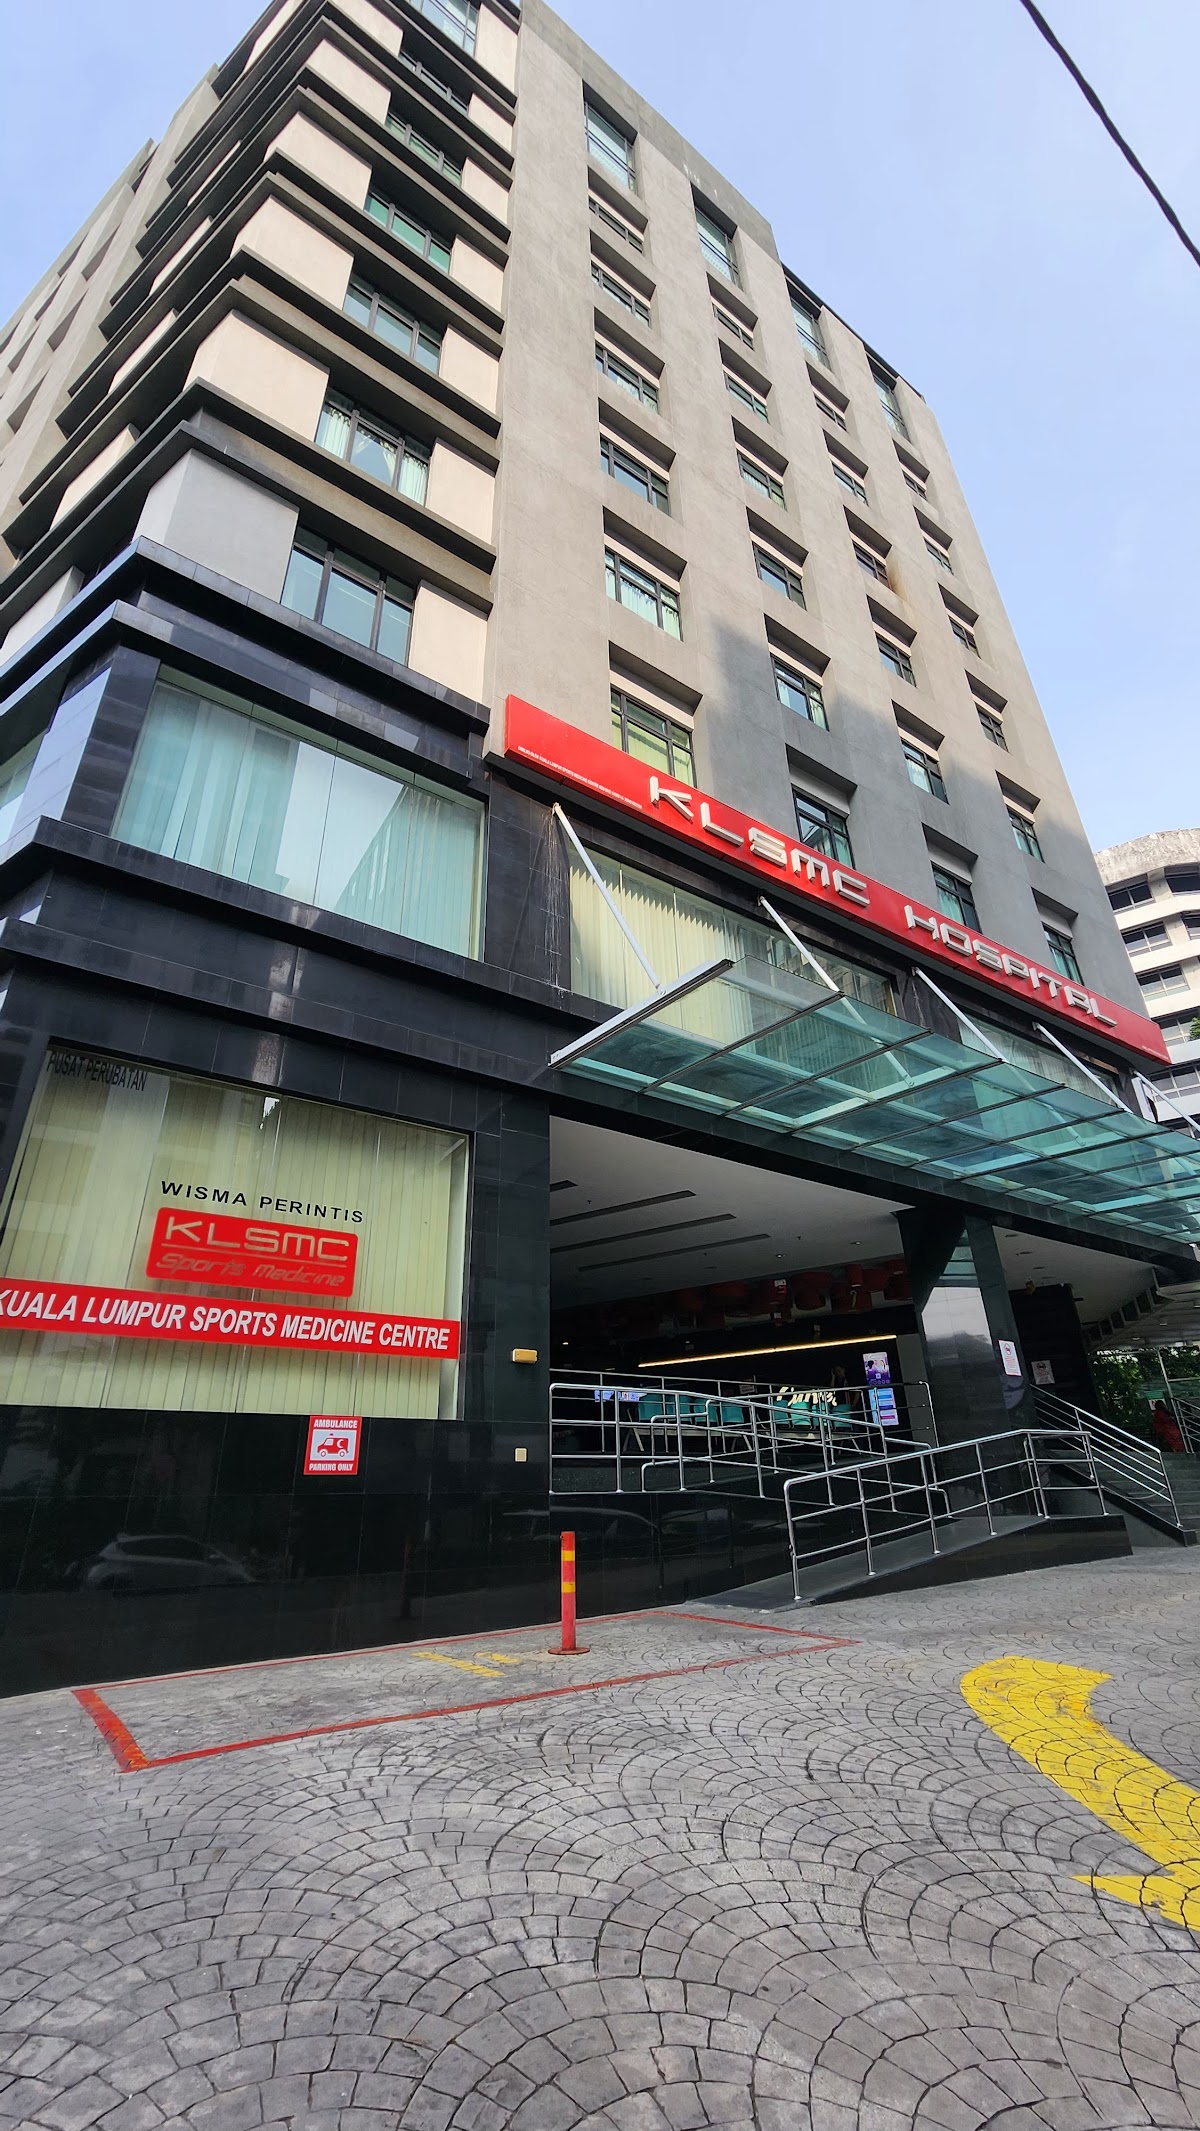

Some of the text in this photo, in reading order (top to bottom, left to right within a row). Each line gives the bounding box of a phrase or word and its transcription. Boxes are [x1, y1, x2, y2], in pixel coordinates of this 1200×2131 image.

[650, 775, 1118, 1027] KLSMC HOSPITAL
[47, 1051, 147, 1091] PUSAT PERUBATAN
[161, 1180, 363, 1223] WISMA PERINTIS
[165, 1216, 349, 1261] KLSMC
[156, 1253, 345, 1287] Sports Medicine
[82, 1297, 186, 1329] LUMPUR
[189, 1306, 277, 1337] SPORTS
[280, 1314, 376, 1344] MEDICINE
[379, 1323, 450, 1350] CENTRE
[313, 1419, 358, 1429] AMBULANCE
[309, 1463, 353, 1471] PARKING ONLY
